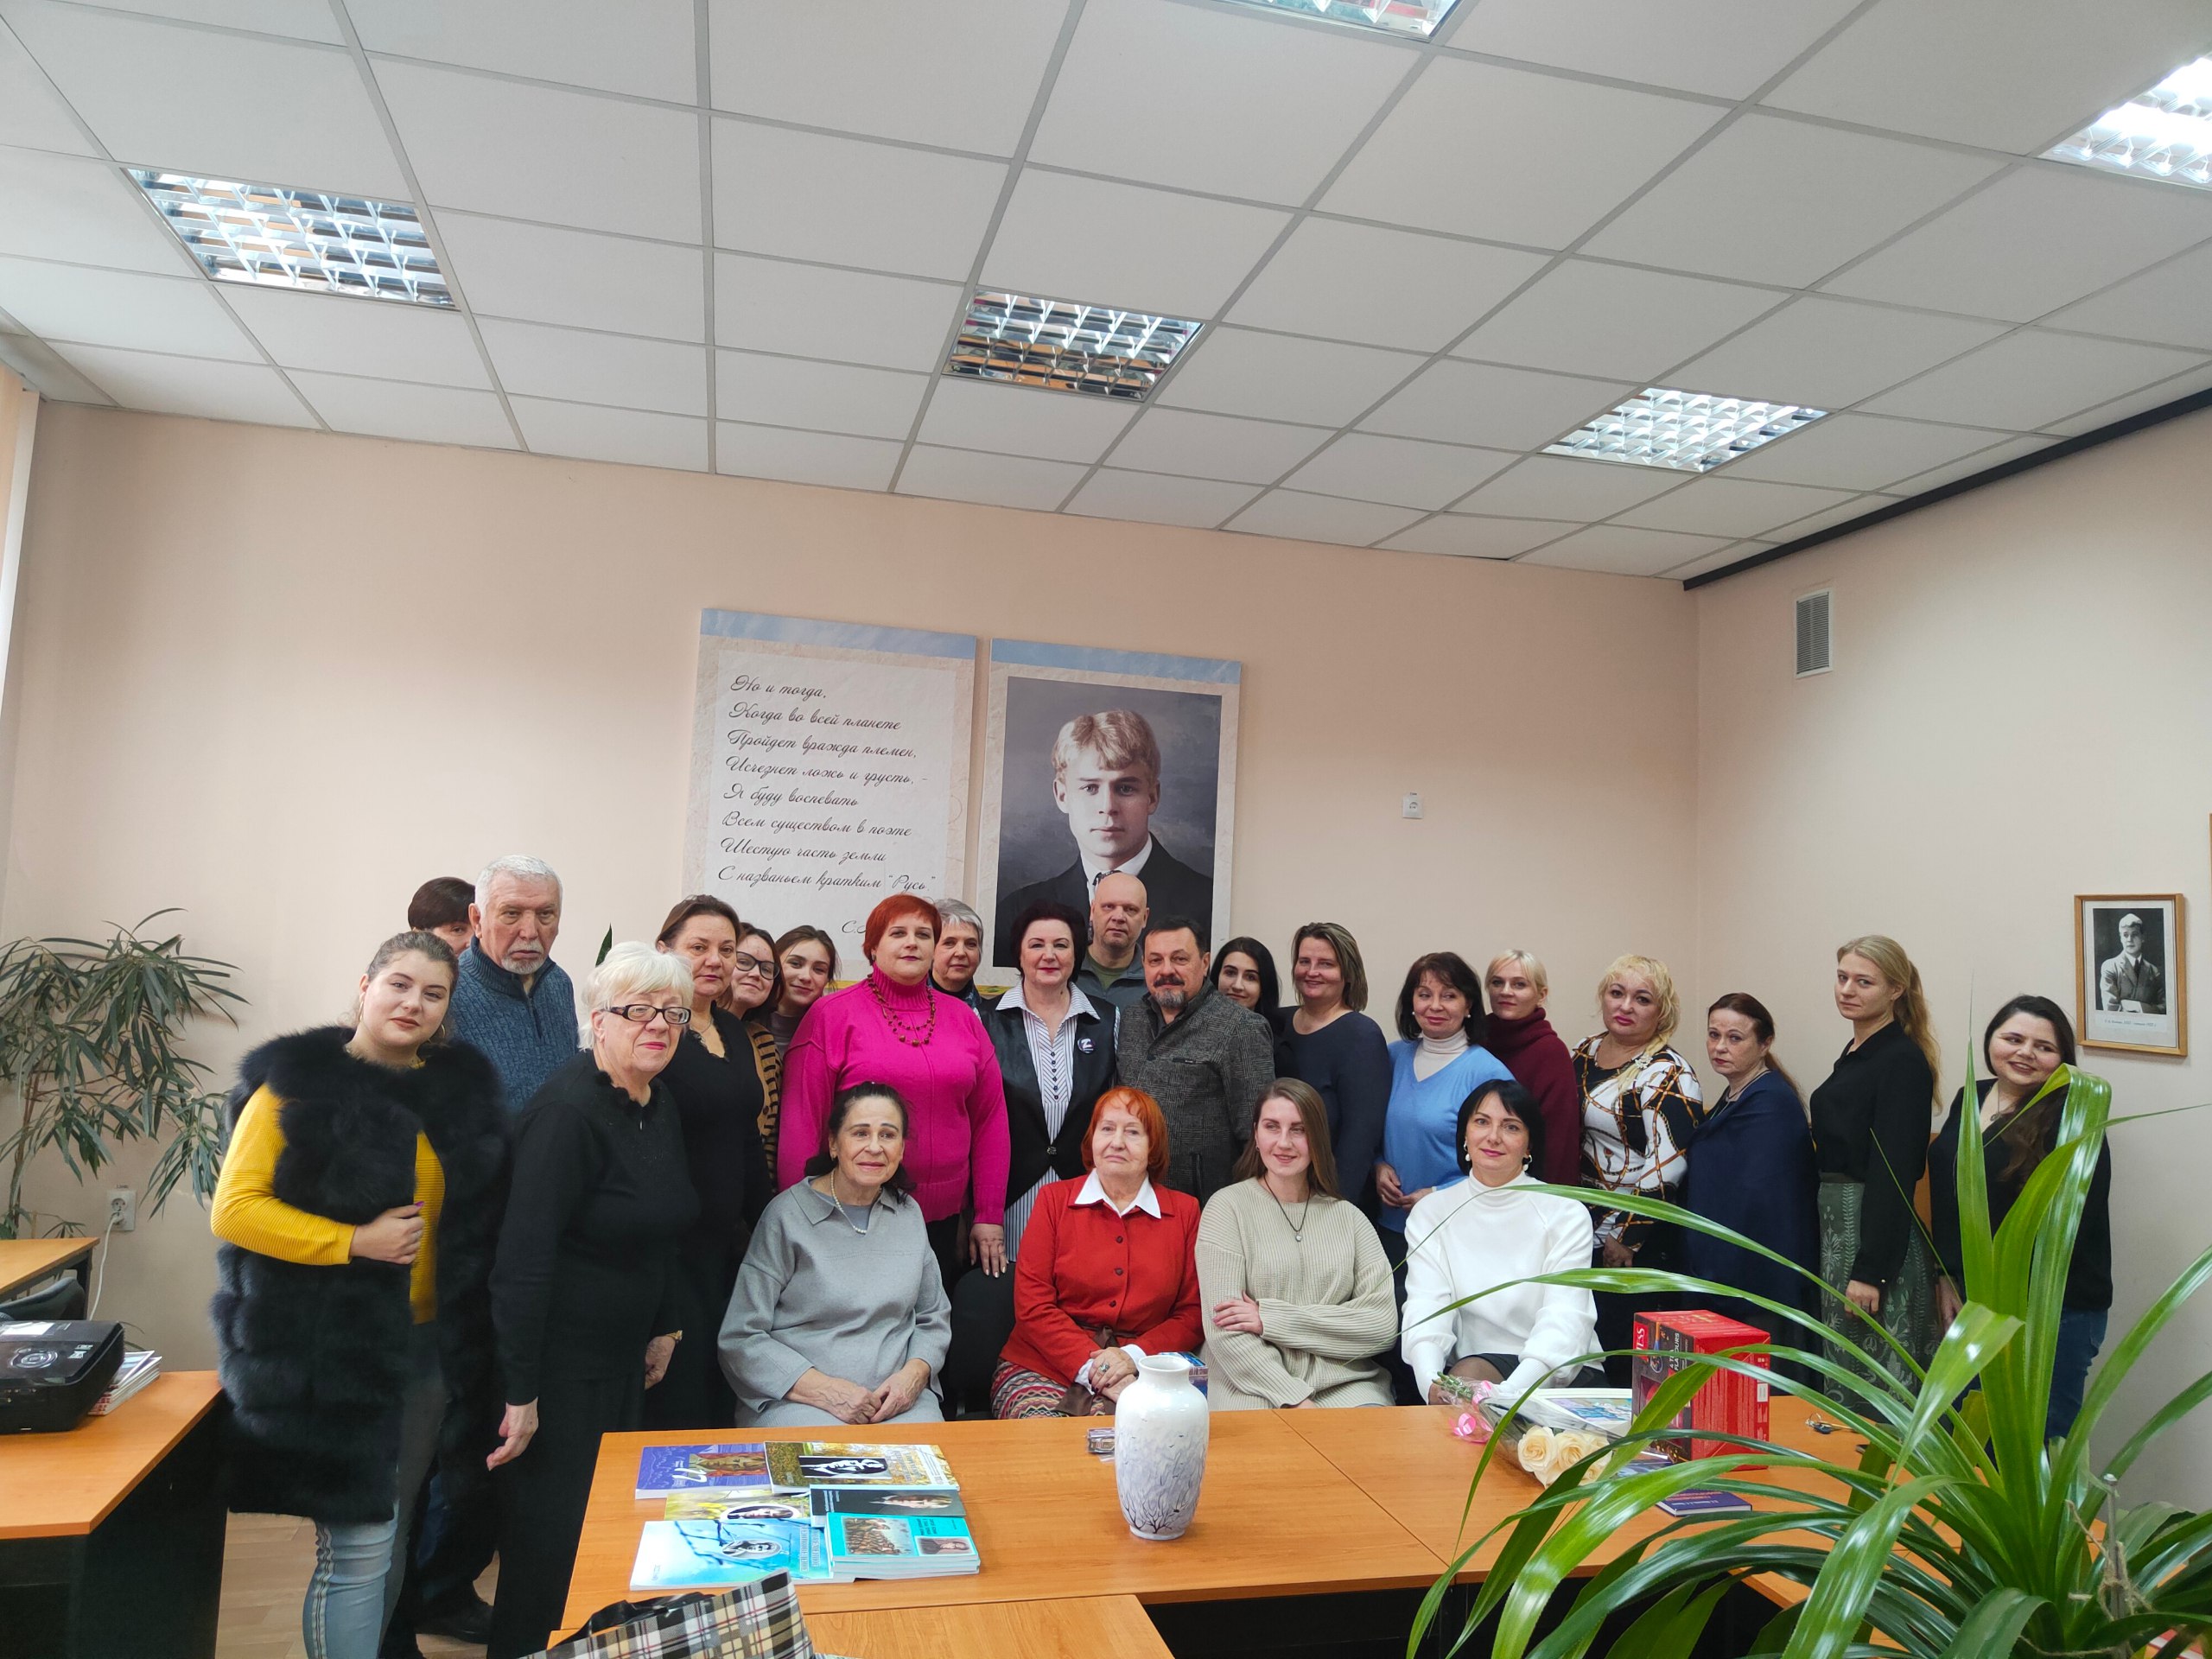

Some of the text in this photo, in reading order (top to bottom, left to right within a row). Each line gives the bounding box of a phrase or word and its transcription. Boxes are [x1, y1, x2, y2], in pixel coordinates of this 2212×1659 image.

[730, 674, 761, 691] Но
[728, 701, 901, 730] Когда во всей планете
[727, 728, 917, 758] Пройдет вражда племен,
[725, 755, 798, 779] Исчезнет
[802, 768, 844, 779] ложь
[723, 783, 858, 806] Я буду воспевать
[721, 810, 912, 836] Всем существом в поэте
[720, 836, 887, 865] Шестую часть земли
[736, 867, 812, 888] названьем
[815, 870, 882, 891] кратким
